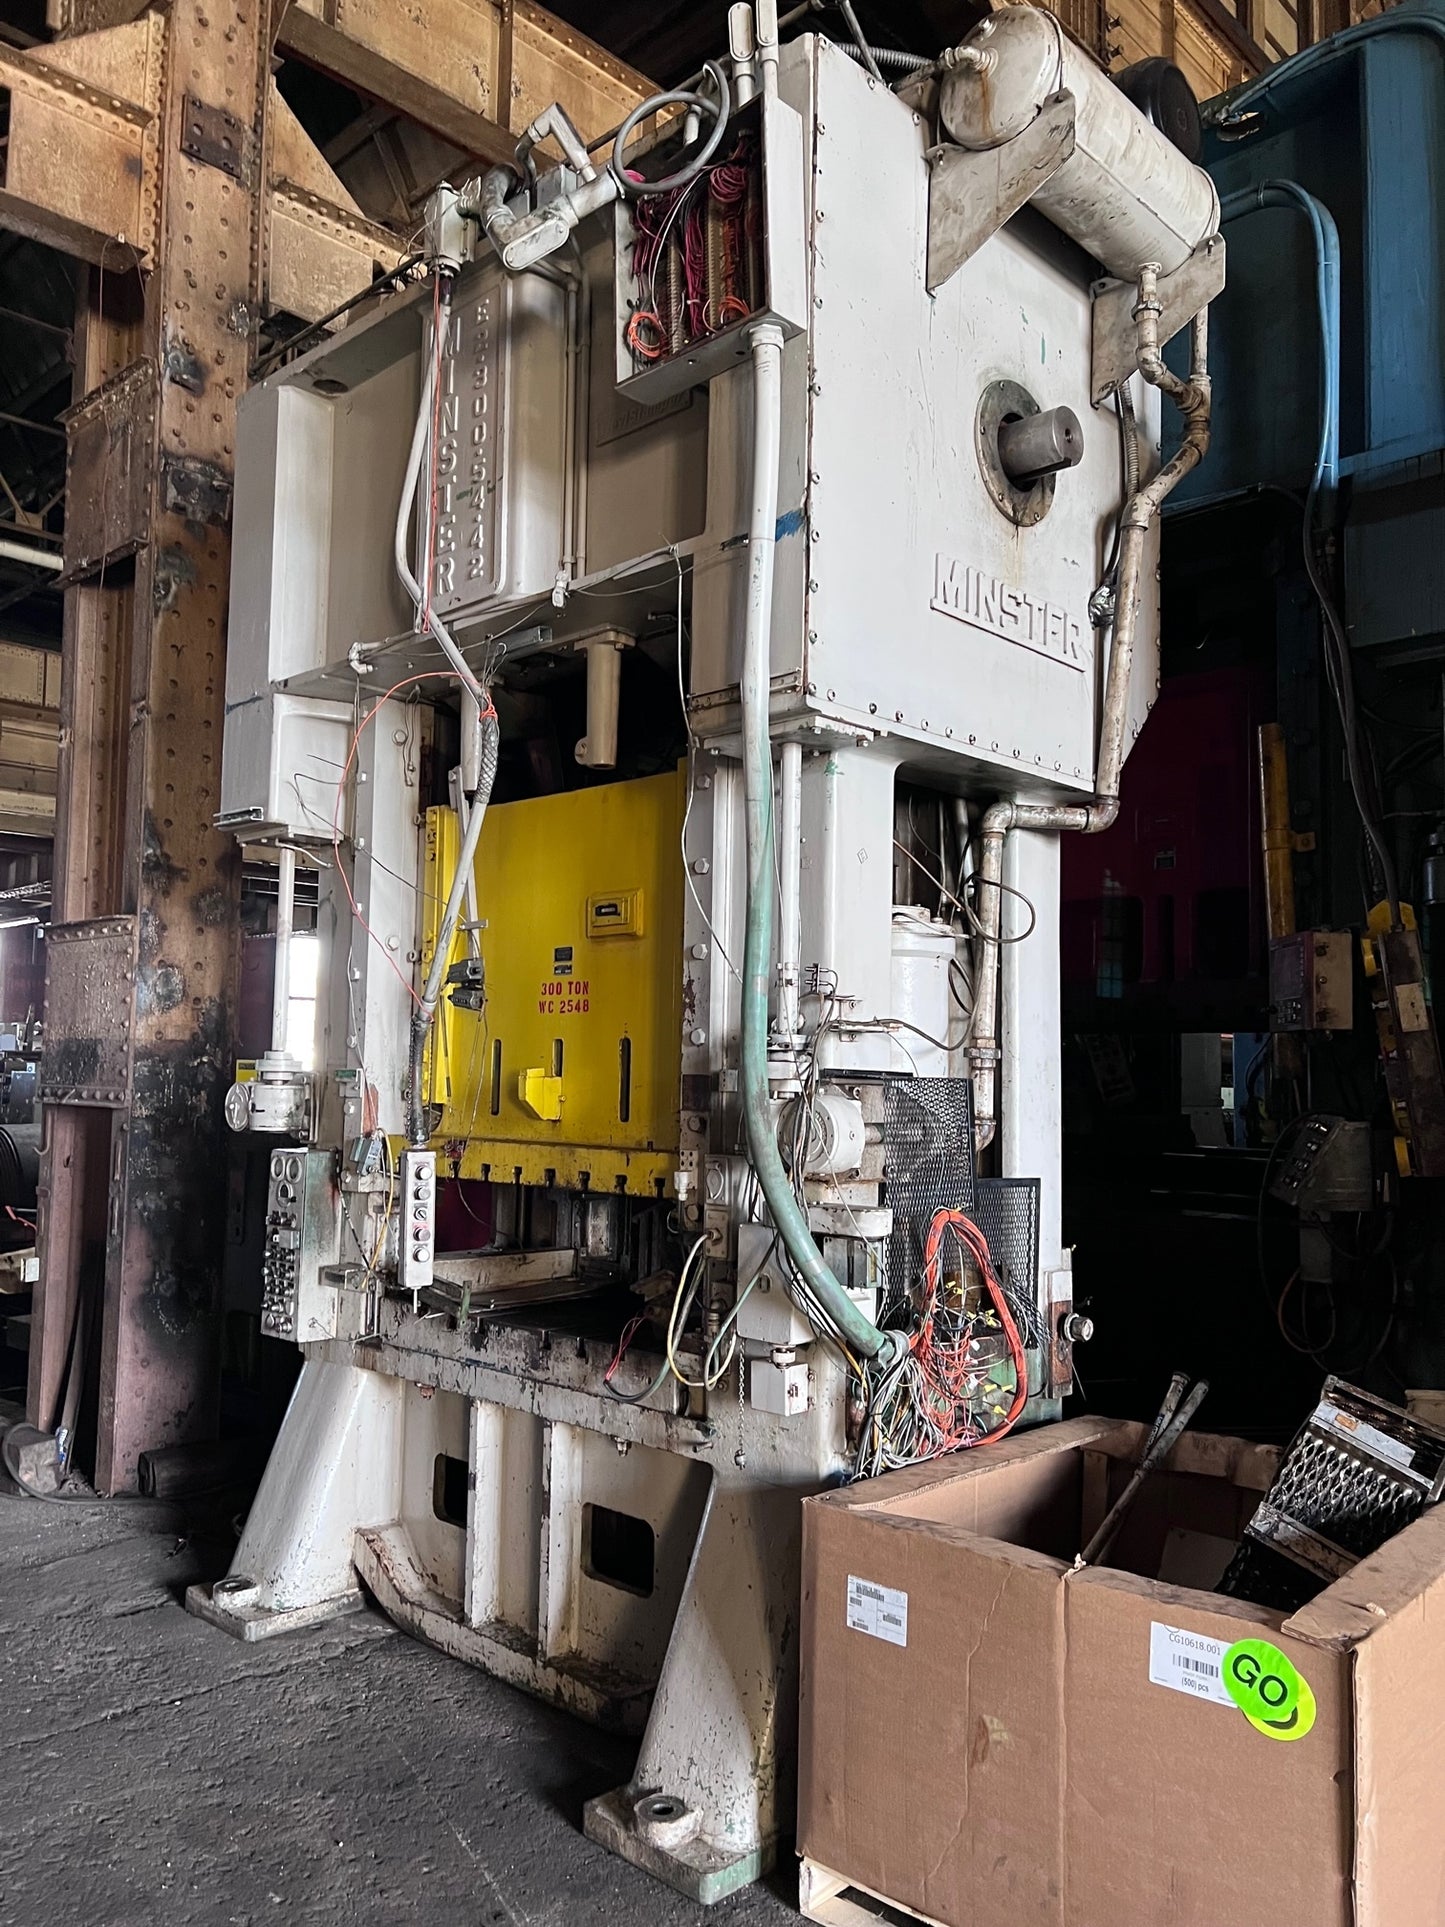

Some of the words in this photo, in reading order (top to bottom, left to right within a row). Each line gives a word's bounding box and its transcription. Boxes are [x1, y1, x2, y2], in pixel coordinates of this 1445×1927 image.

[934, 552, 1090, 665] MINSTER
[541, 982, 562, 996] 300
[568, 981, 589, 995] TON
[539, 1000, 554, 1014] WC
[559, 999, 589, 1013] 2548
[1168, 1633, 1221, 1656] CG10618.001
[1232, 1654, 1288, 1707] GO
